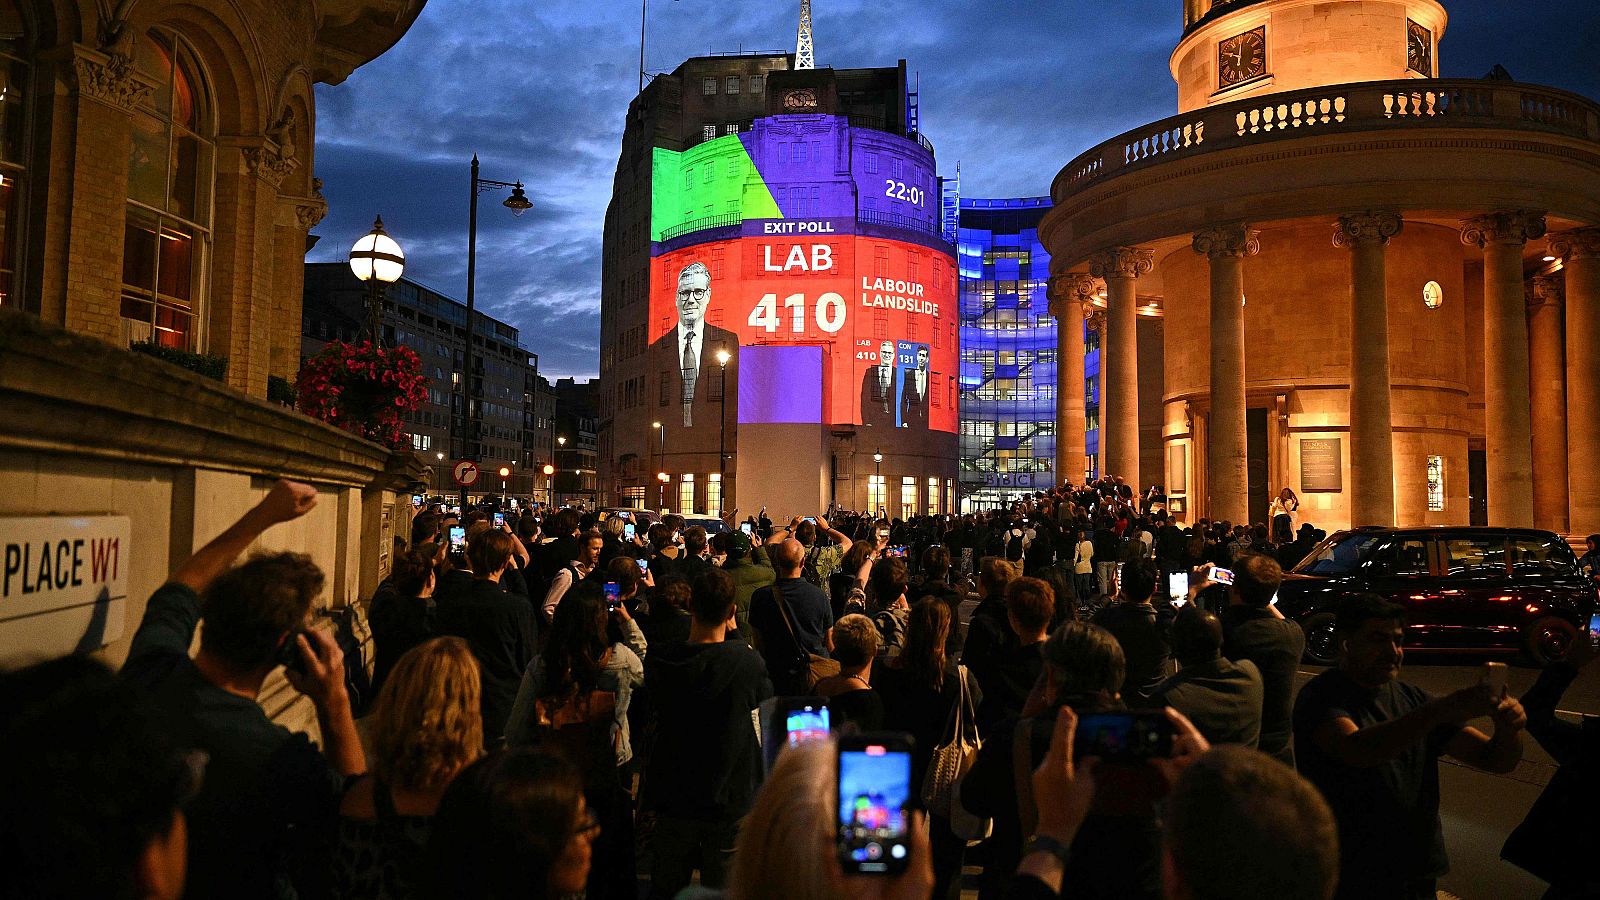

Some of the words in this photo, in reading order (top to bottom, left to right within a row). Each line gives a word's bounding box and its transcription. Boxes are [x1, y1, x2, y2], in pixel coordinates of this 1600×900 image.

[885, 179, 924, 208] 22:01
[764, 222, 795, 234] EXIT
[798, 221, 835, 233] POLL
[764, 244, 833, 272] LAB
[862, 276, 924, 297] LABOUR
[747, 292, 847, 333] 410
[862, 292, 939, 317] LANDSLIDE
[856, 351, 877, 360] 410
[898, 342, 912, 350] CON
[899, 354, 914, 364] 131
[985, 472, 1028, 486] BBC
[3, 539, 85, 598] PLACE
[91, 537, 119, 584] W1
